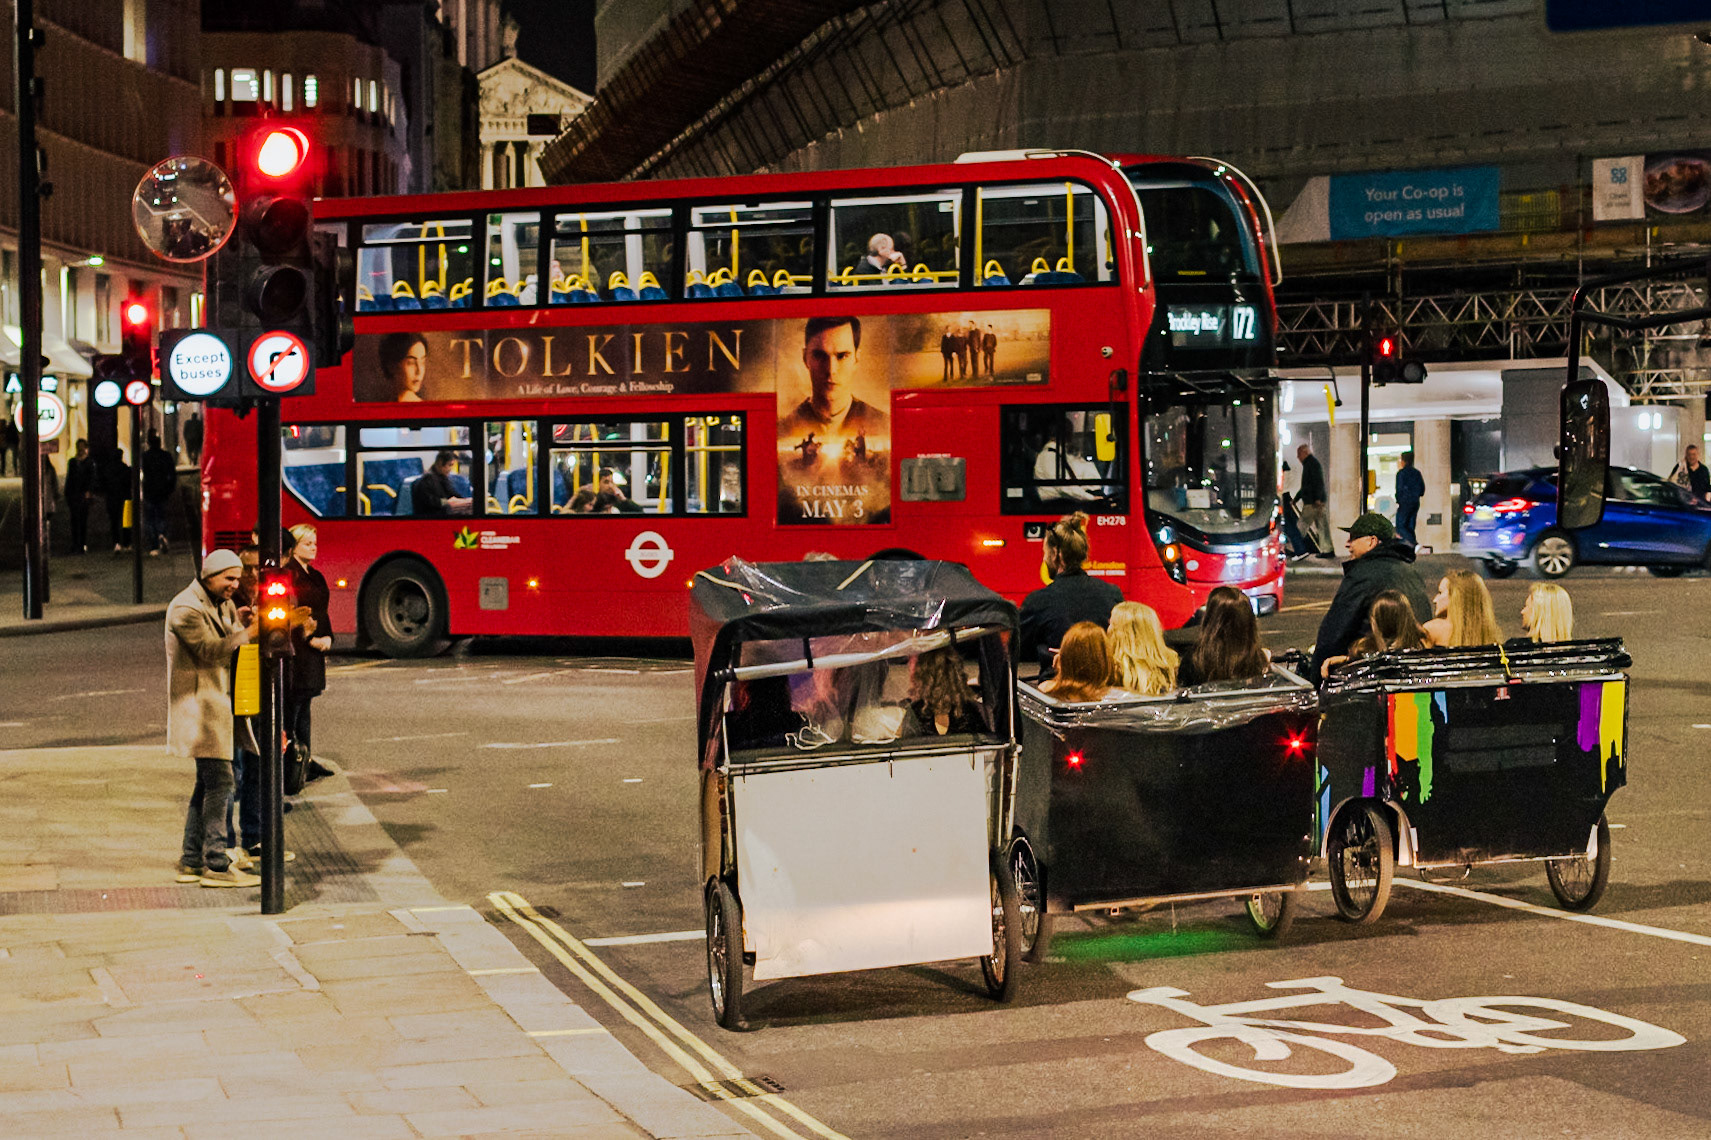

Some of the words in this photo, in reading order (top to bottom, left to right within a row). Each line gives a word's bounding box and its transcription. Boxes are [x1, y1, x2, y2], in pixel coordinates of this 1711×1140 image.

[1364, 188, 1398, 201] Your
[1402, 185, 1449, 201] Co-op
[1452, 184, 1464, 197] is
[1364, 210, 1402, 224] open
[1406, 209, 1422, 220] as
[1426, 203, 1465, 219] usual
[1201, 311, 1218, 330] Rise
[1233, 306, 1255, 339] 172
[176, 351, 225, 365] Except
[450, 329, 743, 379] TOLKIEN
[180, 368, 222, 380] buses
[517, 385, 525, 394] A
[526, 384, 542, 394] Life
[543, 383, 556, 394] of
[556, 383, 579, 395] Love,
[581, 382, 617, 394] Courage
[619, 381, 627, 392] &
[629, 381, 674, 393] Fellowship
[796, 485, 810, 497] IN
[812, 484, 869, 497] CINEMAS
[802, 499, 847, 518] MAY
[853, 499, 864, 518] 3
[1097, 516, 1126, 526] EH278
